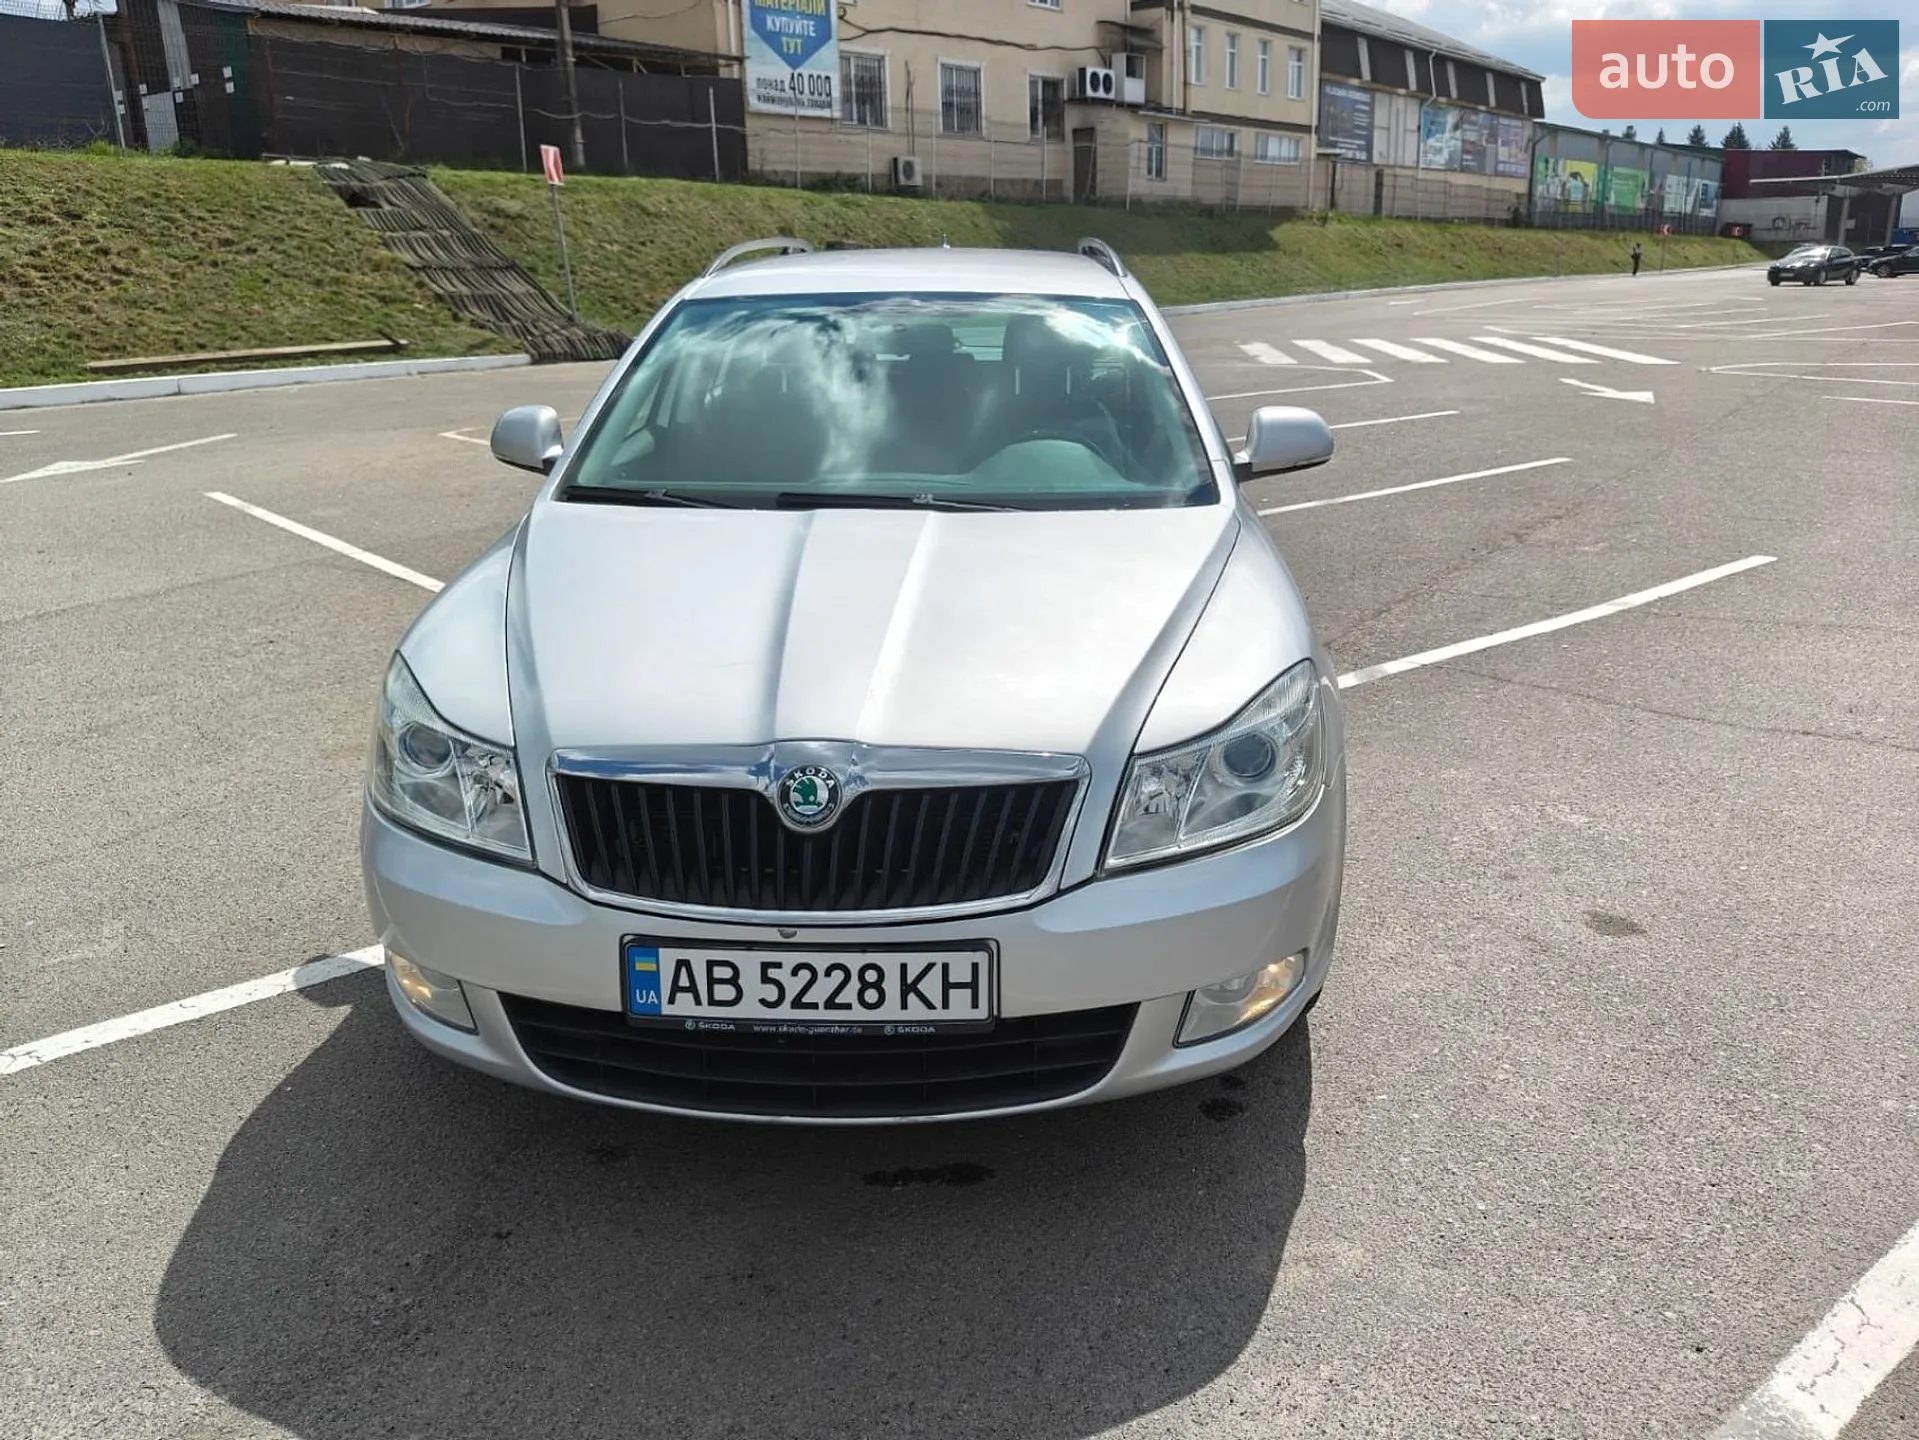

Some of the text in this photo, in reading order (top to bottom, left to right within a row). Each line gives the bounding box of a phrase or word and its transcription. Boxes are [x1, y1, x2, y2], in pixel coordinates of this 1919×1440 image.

[766, 15, 816, 37] КУПУЙТЕ
[782, 37, 803, 54] ТУТ
[636, 958, 980, 1010] UA AB 5228 KH
